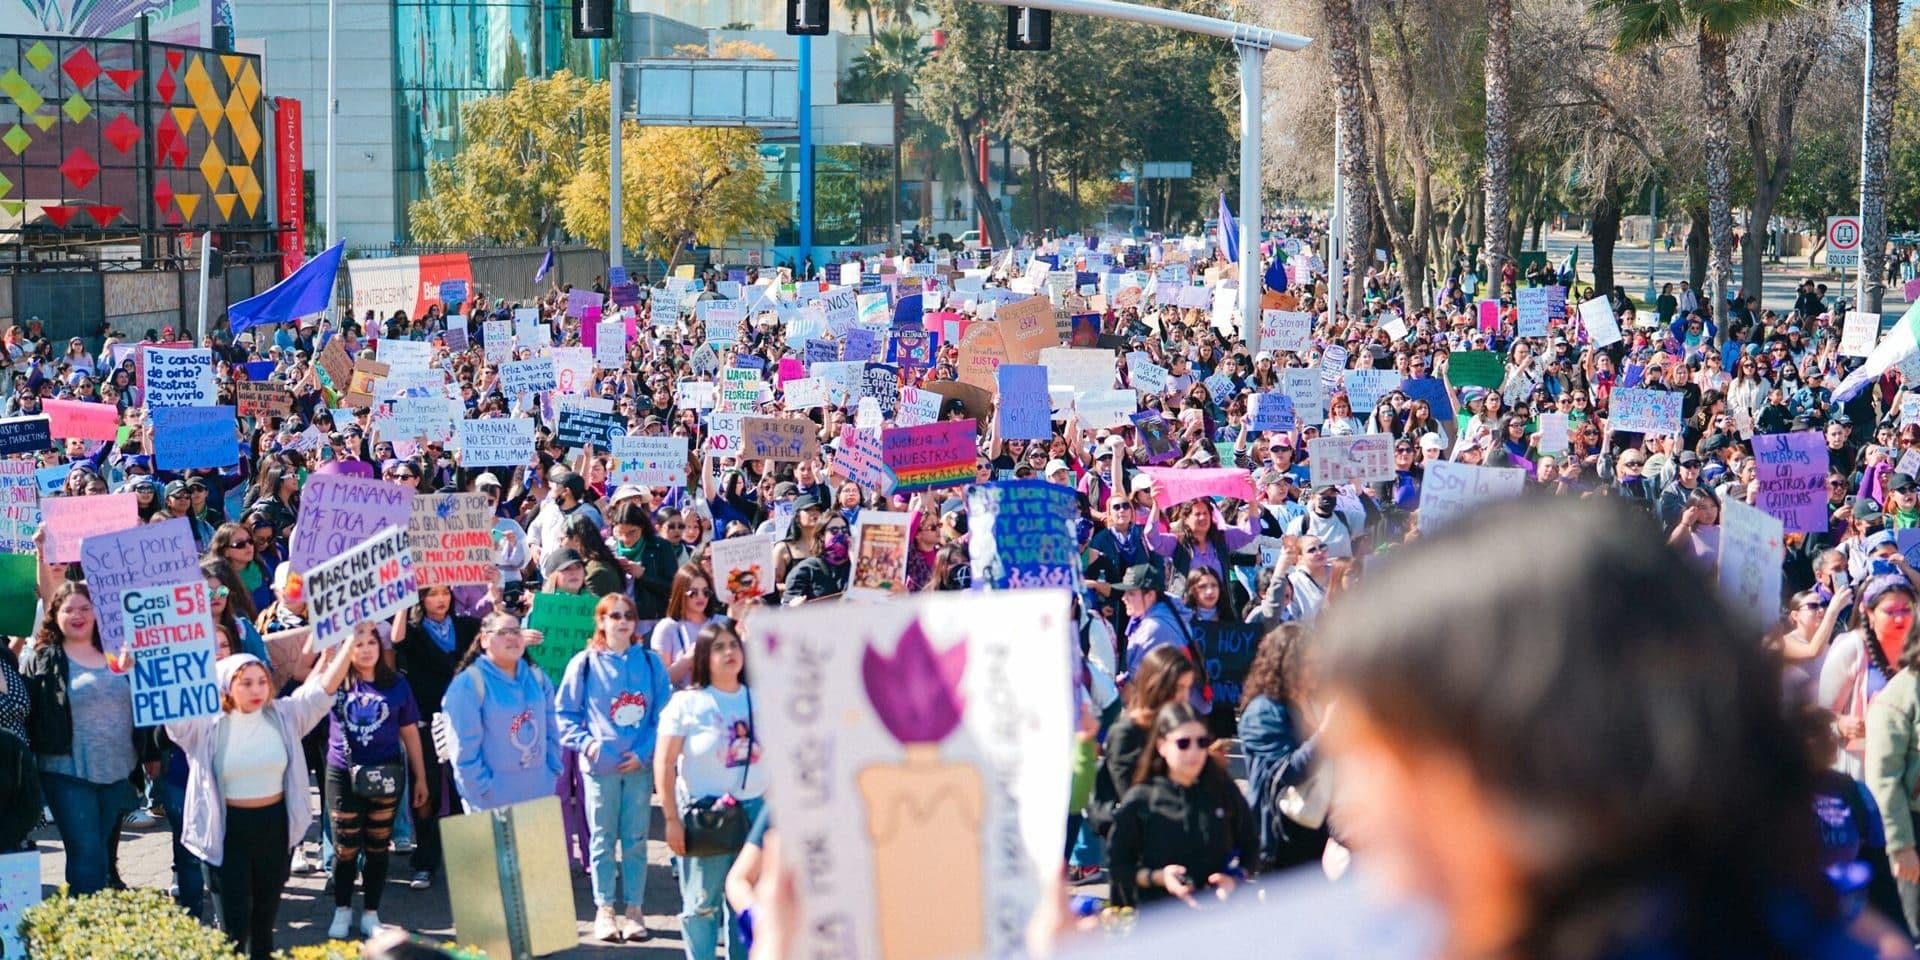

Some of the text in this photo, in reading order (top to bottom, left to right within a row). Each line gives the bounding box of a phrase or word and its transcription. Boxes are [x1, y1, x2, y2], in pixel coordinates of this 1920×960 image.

[288, 107, 298, 235] INTERCERAMIC
[1829, 255, 1845, 264] SOLO
[1264, 328, 1276, 338] NO
[147, 351, 210, 365] Te cansas
[148, 367, 162, 378] de
[863, 370, 897, 382] SOMOS
[1137, 361, 1164, 376] JUSTICE
[147, 379, 196, 390] Nosotras
[737, 380, 743, 389] A
[872, 379, 896, 390] GRITO
[1137, 374, 1160, 387] WOMAN
[148, 390, 203, 400] de vivirlo
[861, 385, 896, 396] DE LAS
[903, 388, 918, 405] NO
[733, 401, 738, 410] Y
[464, 420, 518, 432] SI MAÑANA
[9, 432, 47, 445] MARKETING
[466, 435, 478, 445] NO
[709, 434, 728, 450] NO
[889, 434, 932, 450] Justicia
[942, 431, 950, 443] X
[1776, 435, 1789, 450] SI
[464, 449, 528, 460] A MIS ALUMNA
[892, 448, 959, 466] NUESTRXS
[1760, 450, 1810, 465] MIRARAS
[899, 463, 974, 484] HERMANXS
[1428, 464, 1466, 494] Soy
[309, 481, 402, 506] SI MAÑANA
[466, 495, 488, 511] POR
[301, 506, 388, 534] ME TOCA A
[409, 517, 420, 531] AS
[409, 531, 492, 550] AMOS CALLADAS
[86, 535, 184, 573] Se te pone
[412, 551, 423, 563] OR
[425, 551, 465, 562] MIEDO
[476, 549, 491, 561] SER
[308, 532, 410, 597] MARCHO POR LA
[87, 566, 139, 591] grande
[414, 563, 489, 587] SESINADAS
[313, 558, 399, 616] VEZ QUE NO
[123, 587, 195, 616] Casi 5
[316, 576, 418, 640] ME CREYERON
[131, 623, 205, 650] JUSTICIA
[1218, 630, 1255, 655] HOY
[134, 647, 171, 660] para
[134, 650, 212, 690] NERY
[134, 682, 220, 724] PELAYO
